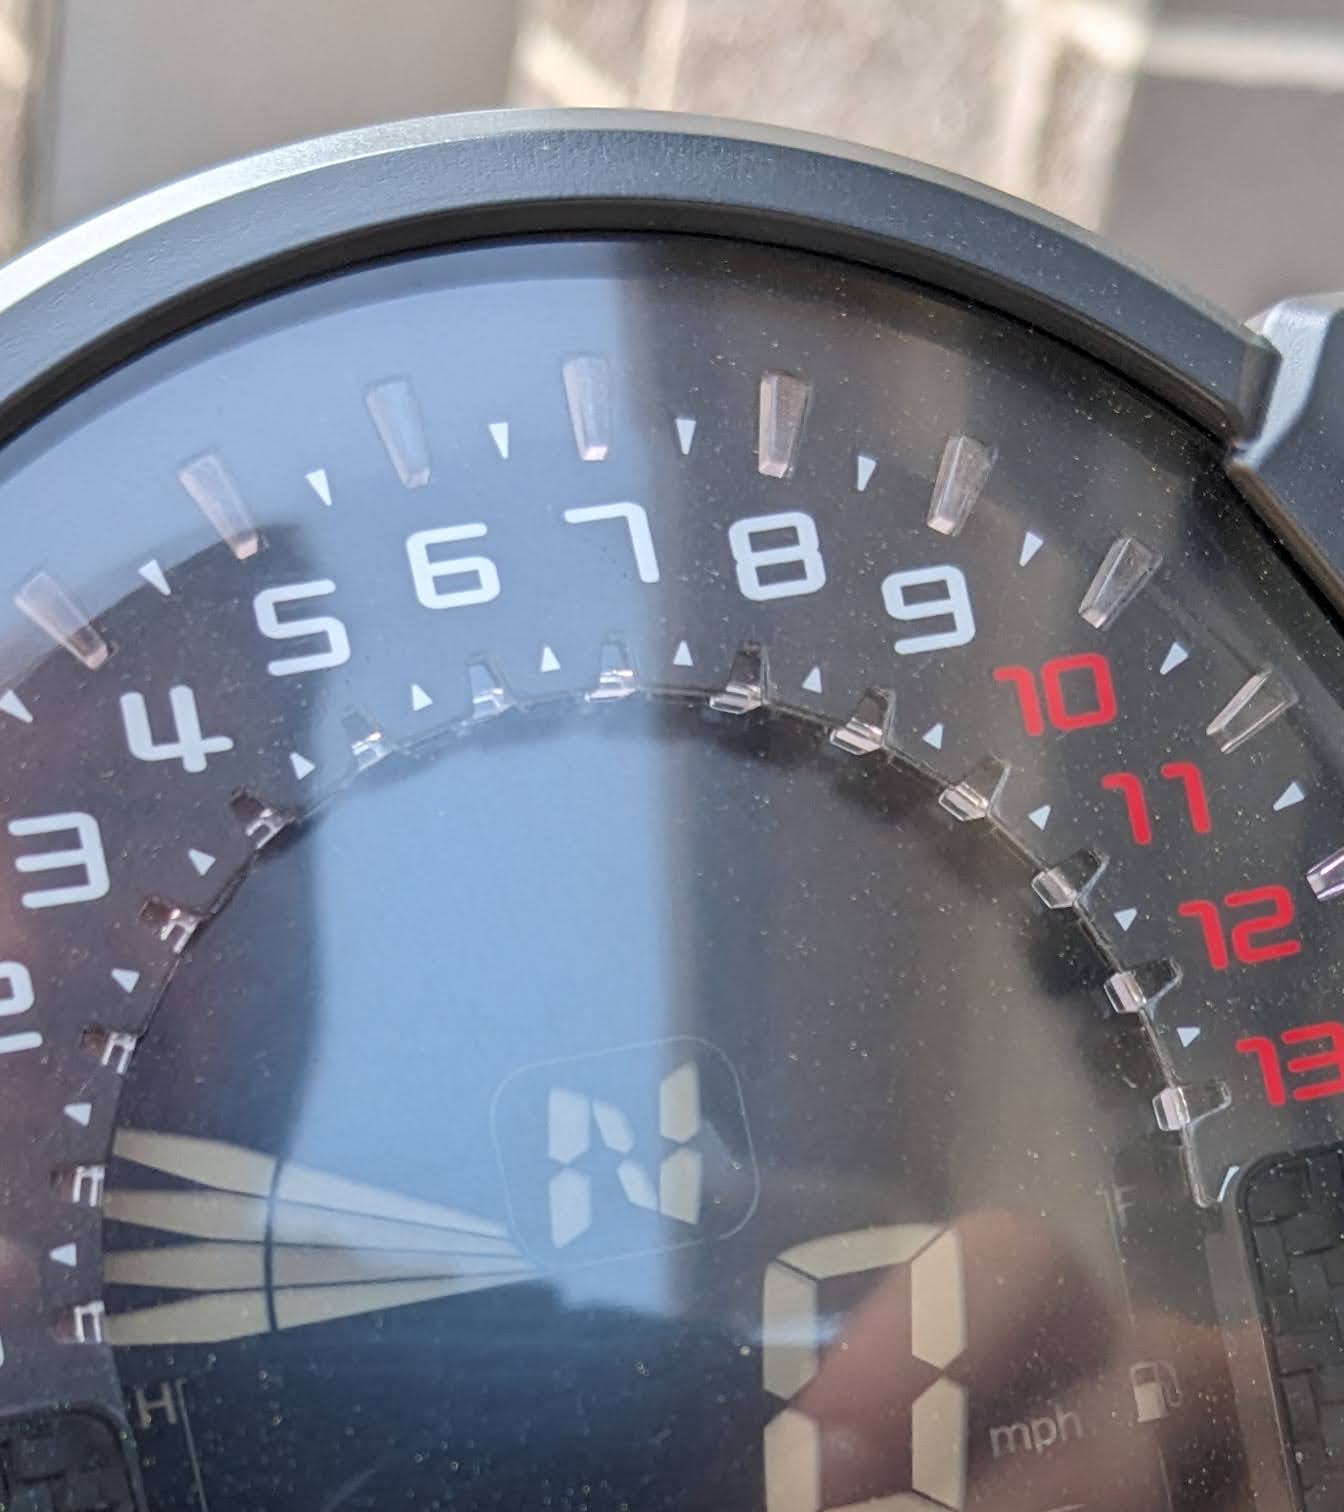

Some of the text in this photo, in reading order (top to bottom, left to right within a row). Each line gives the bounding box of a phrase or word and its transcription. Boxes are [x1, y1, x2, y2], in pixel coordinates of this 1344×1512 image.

[406, 523, 501, 609] 6
[563, 502, 659, 583] 7
[728, 512, 826, 600] 8
[253, 579, 351, 676] 5
[881, 565, 976, 655] 9
[120, 685, 233, 773] 4
[994, 653, 1117, 736] 10
[1102, 762, 1210, 844] 11
[7, 812, 109, 908] 3
[1178, 885, 1300, 970] 12
[548, 1060, 703, 1249] N
[136, 1381, 178, 1429] H
[989, 1408, 1083, 1457] mph
